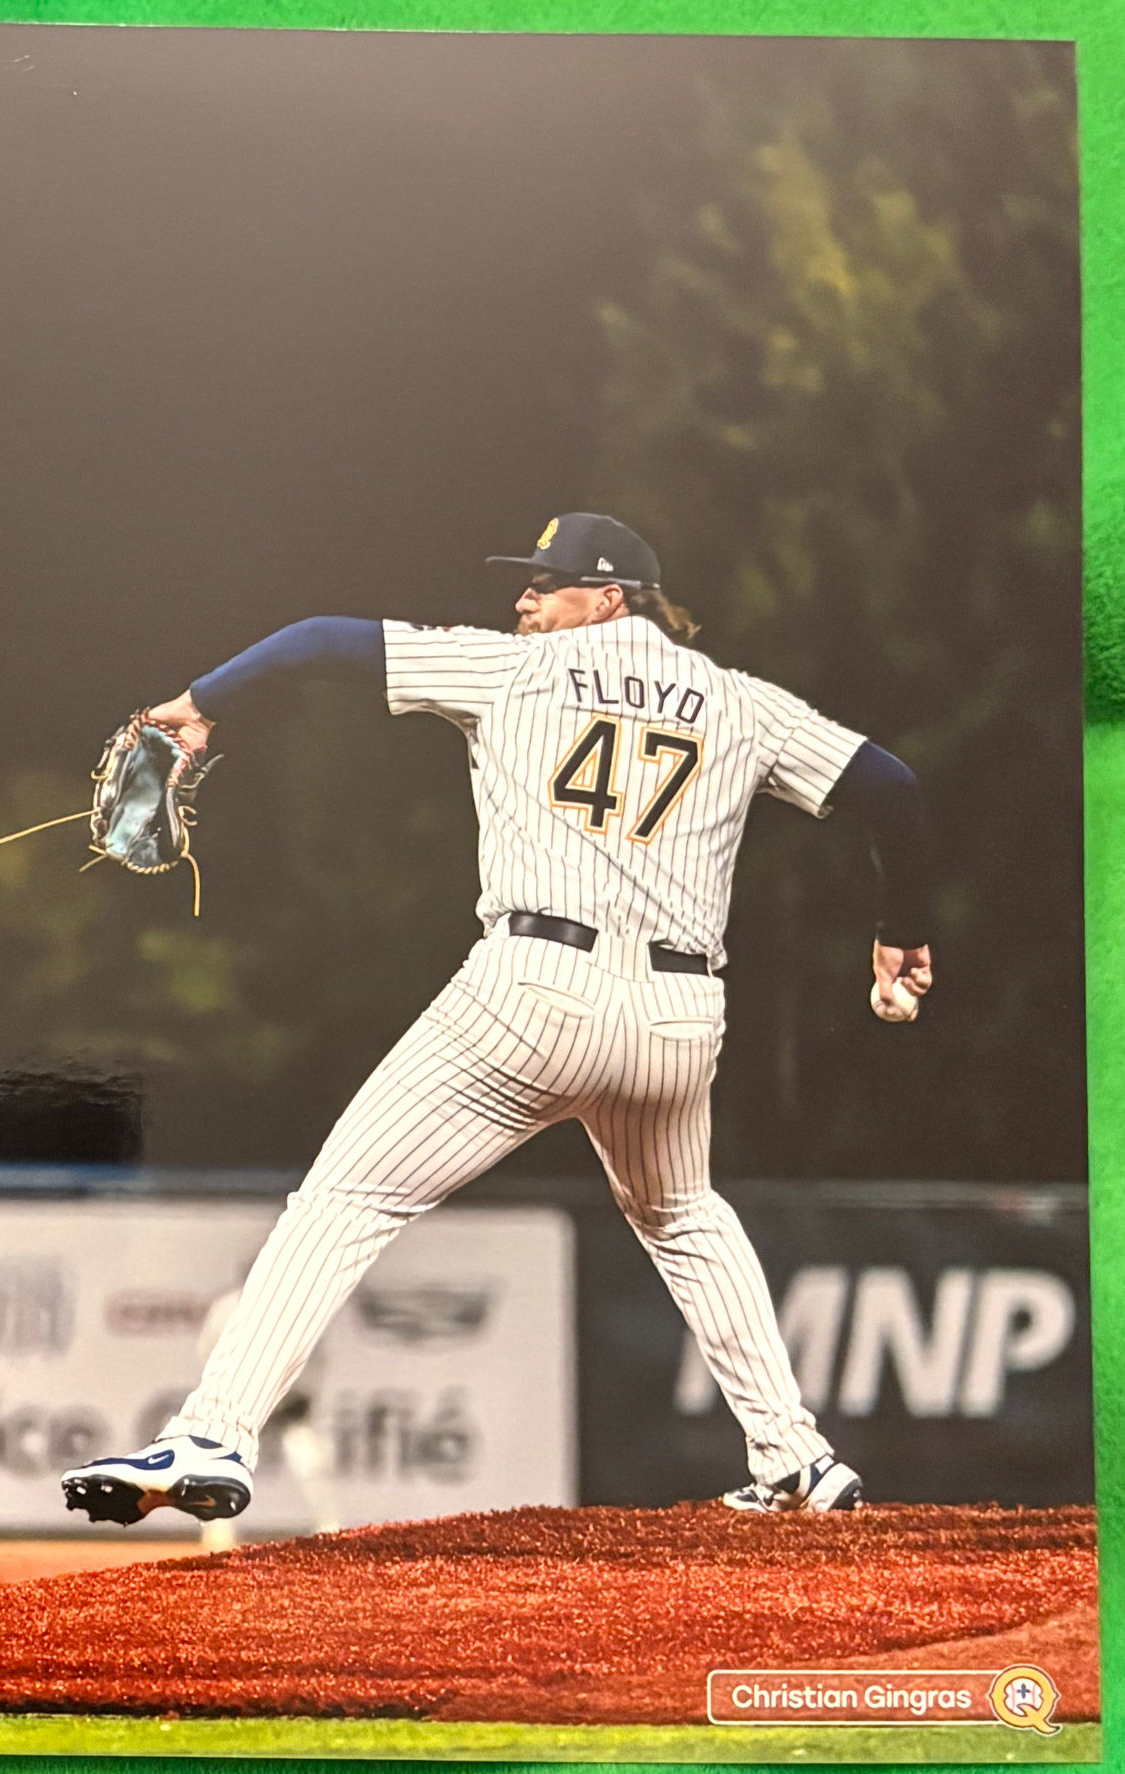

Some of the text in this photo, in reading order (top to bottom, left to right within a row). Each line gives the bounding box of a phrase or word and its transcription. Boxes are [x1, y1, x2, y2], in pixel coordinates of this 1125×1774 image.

[567, 667, 705, 724] FLOYD
[547, 713, 704, 846] 47
[675, 1264, 1075, 1418] MNP
